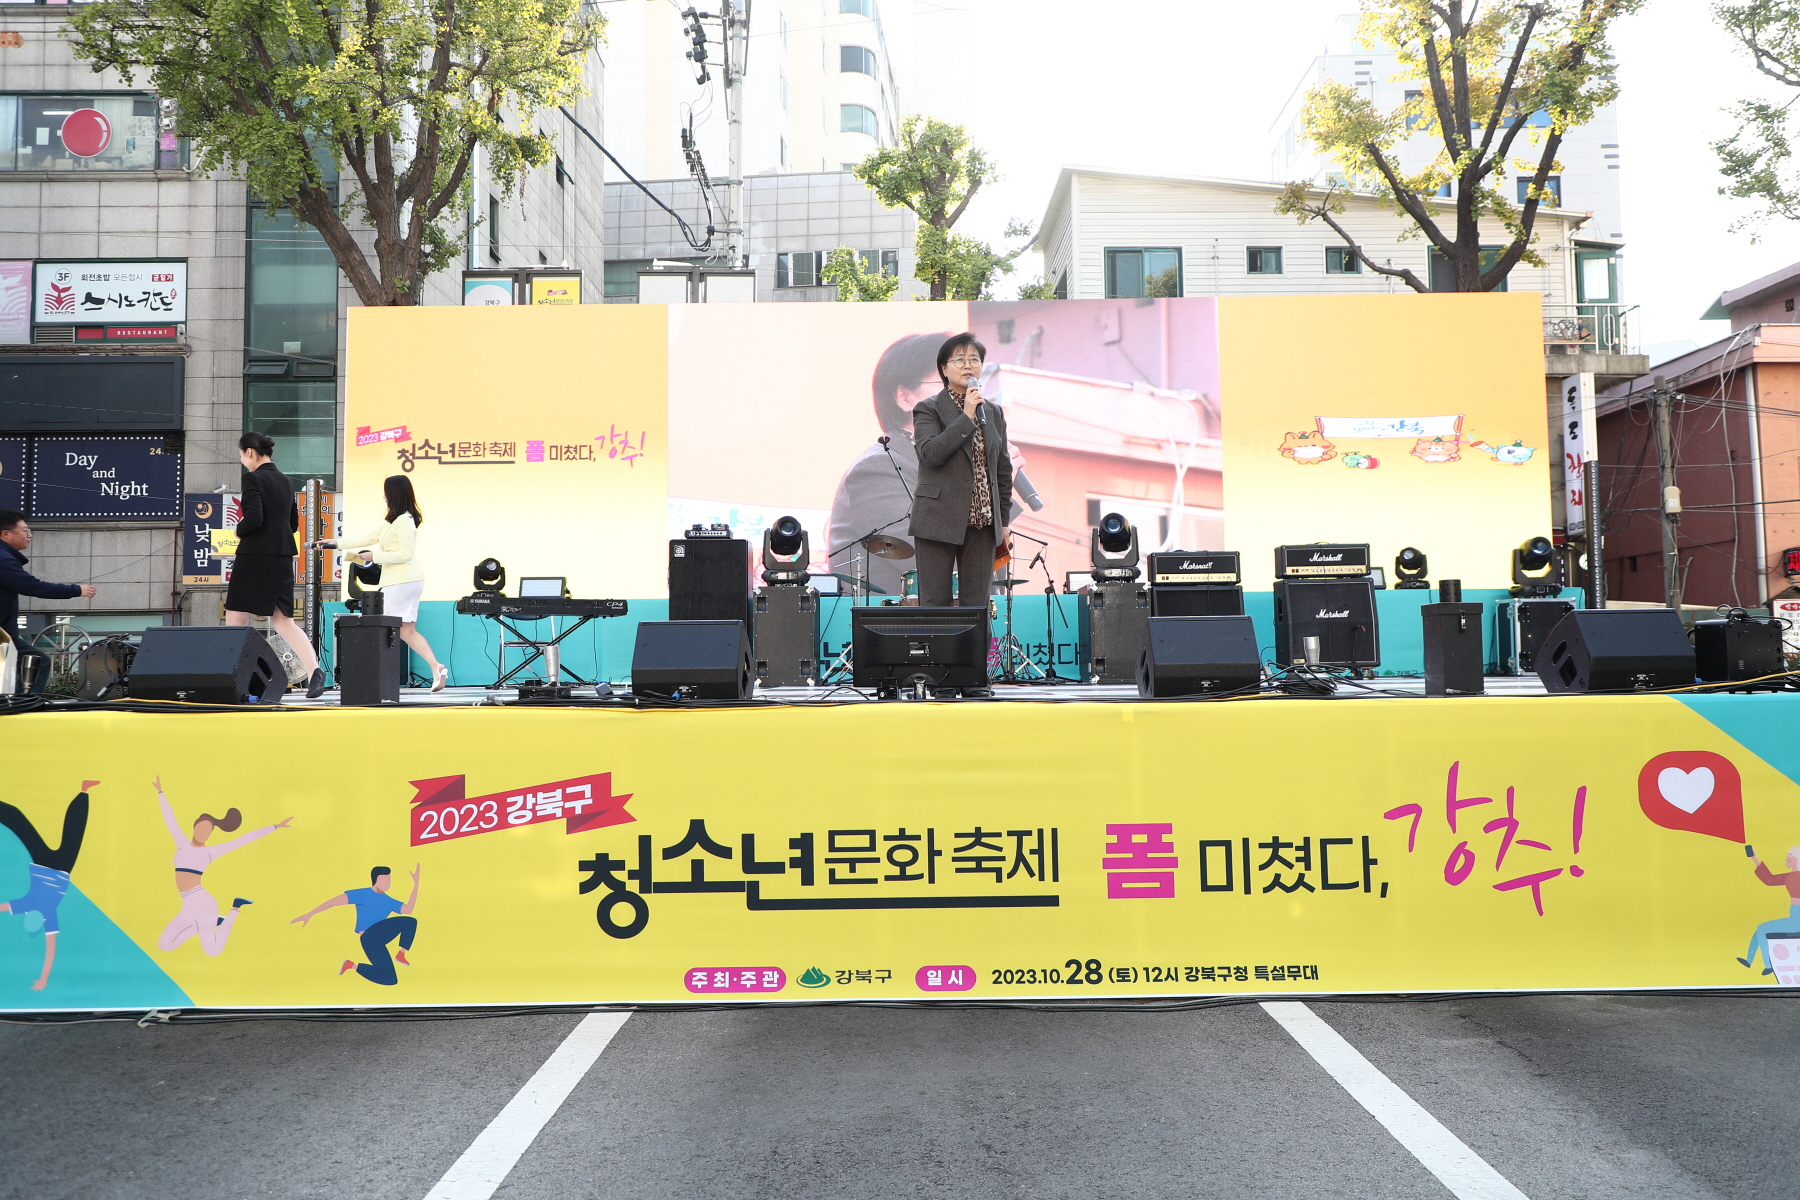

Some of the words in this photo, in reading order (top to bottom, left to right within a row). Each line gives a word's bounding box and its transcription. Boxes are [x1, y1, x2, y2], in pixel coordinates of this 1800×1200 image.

[57, 272, 70, 282] 3F
[81, 273, 110, 282] 회전초밥
[113, 273, 143, 282] 모든접시
[357, 432, 380, 445] 2023
[379, 428, 403, 441] 강북구
[65, 451, 99, 470] Day
[525, 440, 546, 462] 폼
[549, 444, 597, 463] 미쳤다,
[92, 467, 116, 479] and
[100, 480, 149, 500] Night
[1309, 551, 1344, 563] Marshall
[1315, 608, 1350, 619] Marshall
[418, 799, 499, 841] 2023
[505, 782, 594, 826] 강북구
[1101, 822, 1179, 900] 폼
[1198, 834, 1390, 900] 미쳤다,
[1383, 760, 1588, 918] 강추!
[834, 968, 893, 986] 강북구
[991, 958, 1104, 985] 2023.10.28
[1108, 966, 1139, 984] (토)
[1142, 965, 1180, 983] 12시
[1183, 964, 1249, 983] 강북구청
[1253, 963, 1320, 982] 특설무대
